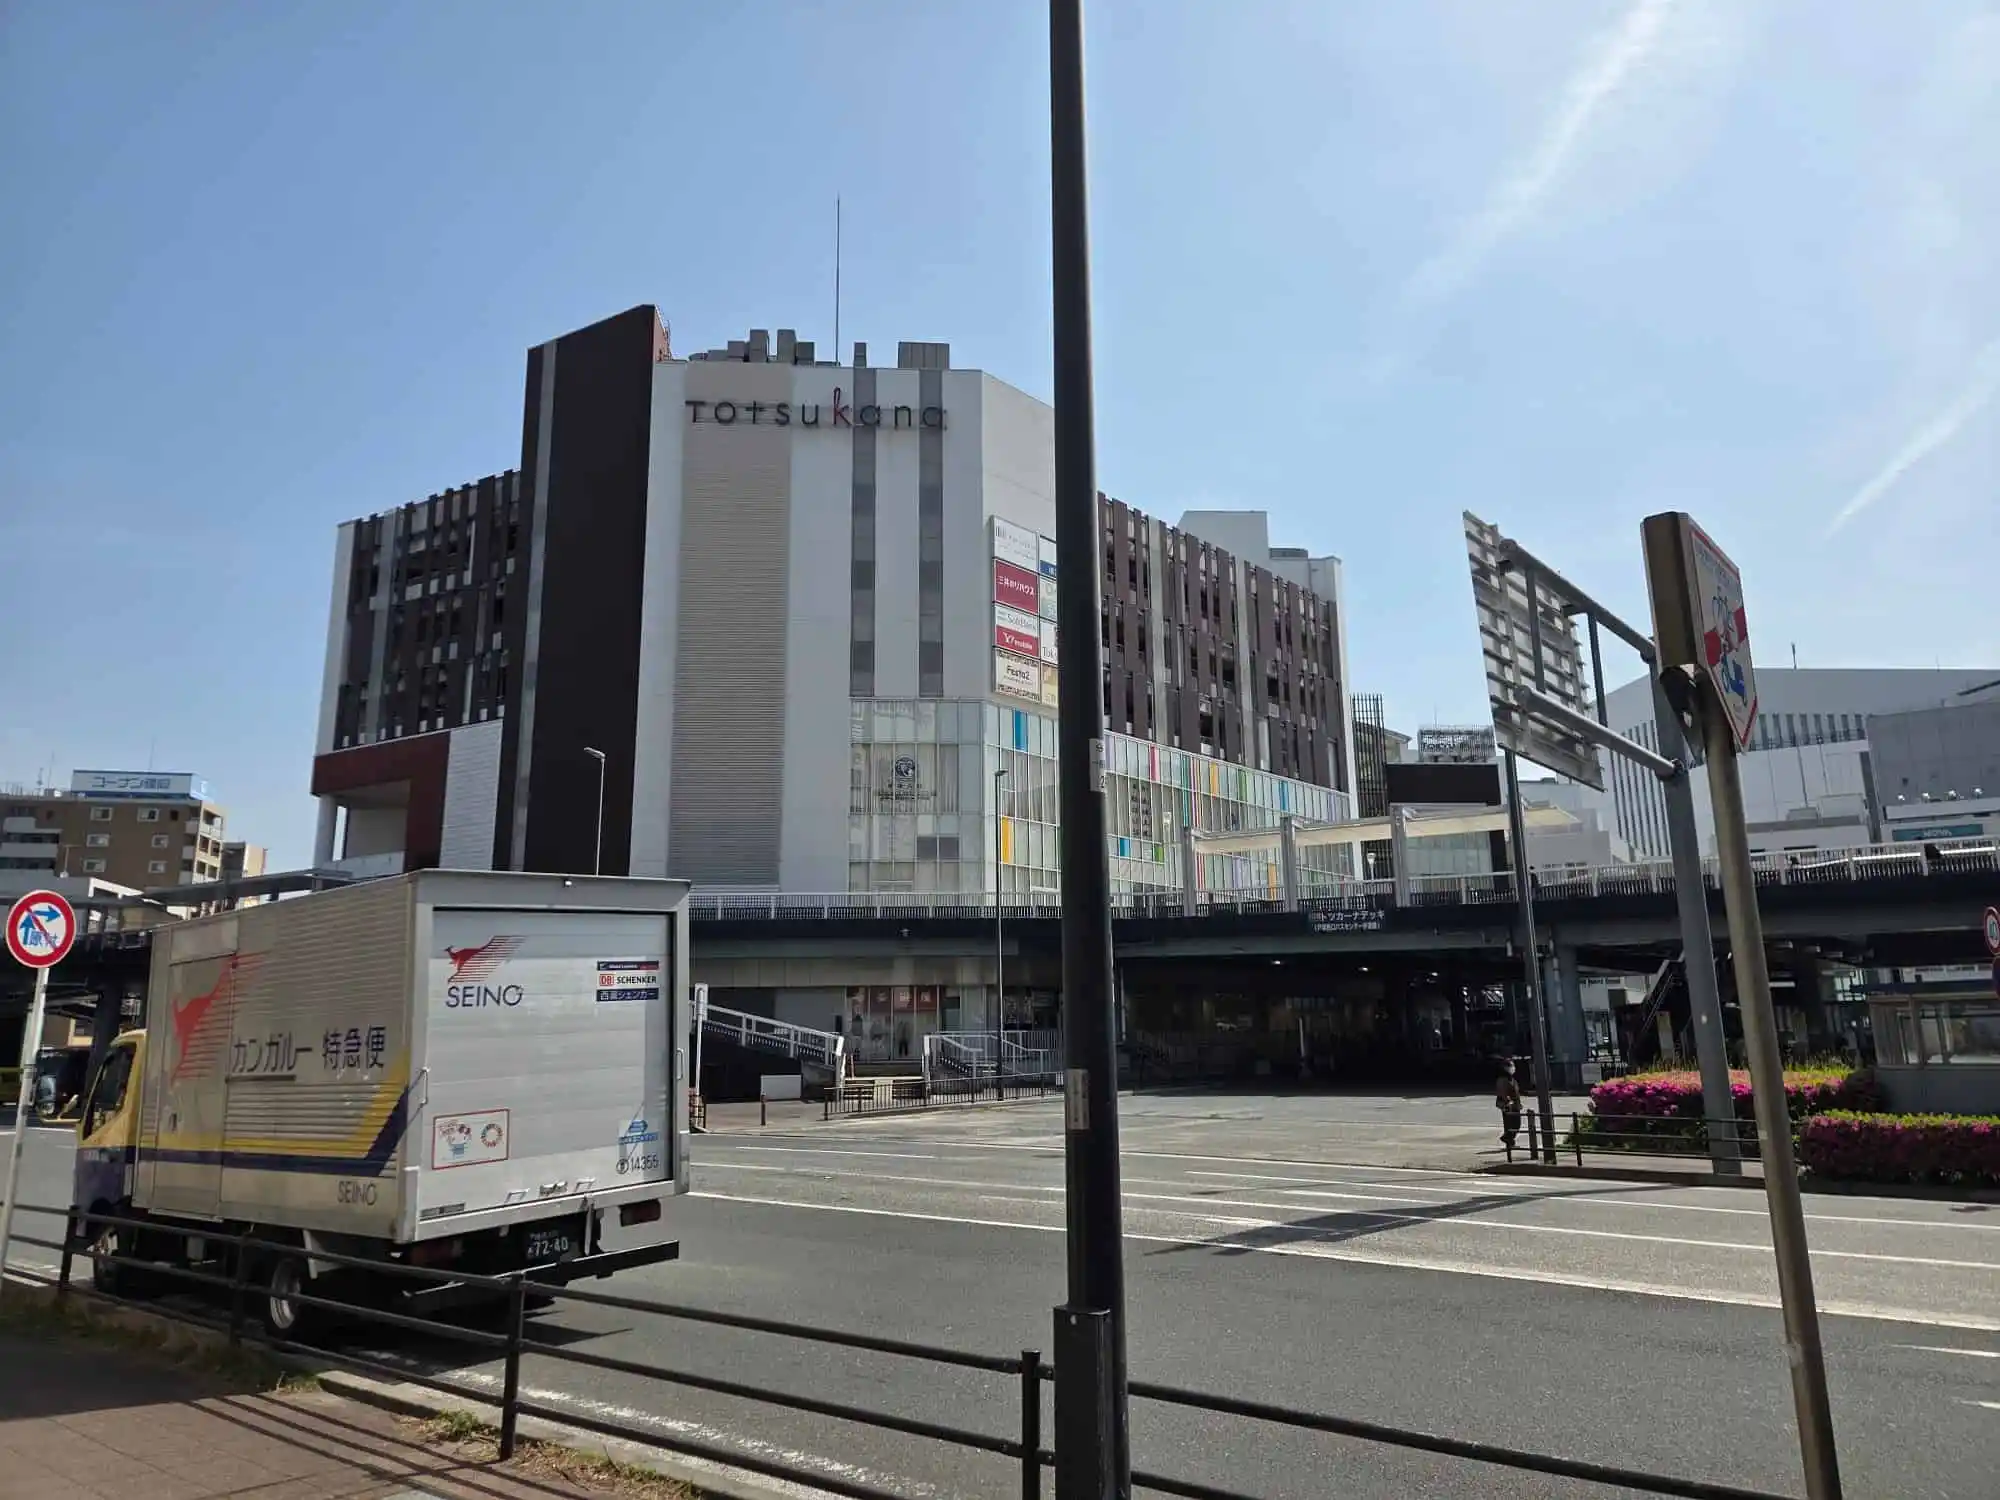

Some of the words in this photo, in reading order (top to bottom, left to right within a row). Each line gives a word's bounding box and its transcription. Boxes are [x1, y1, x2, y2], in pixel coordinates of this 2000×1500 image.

[616, 975, 657, 985] SCHENKER
[446, 984, 524, 1008] SEINO
[232, 1031, 313, 1073] カンガルー
[321, 1025, 387, 1069] 特急便
[337, 1180, 378, 1206] SEINO
